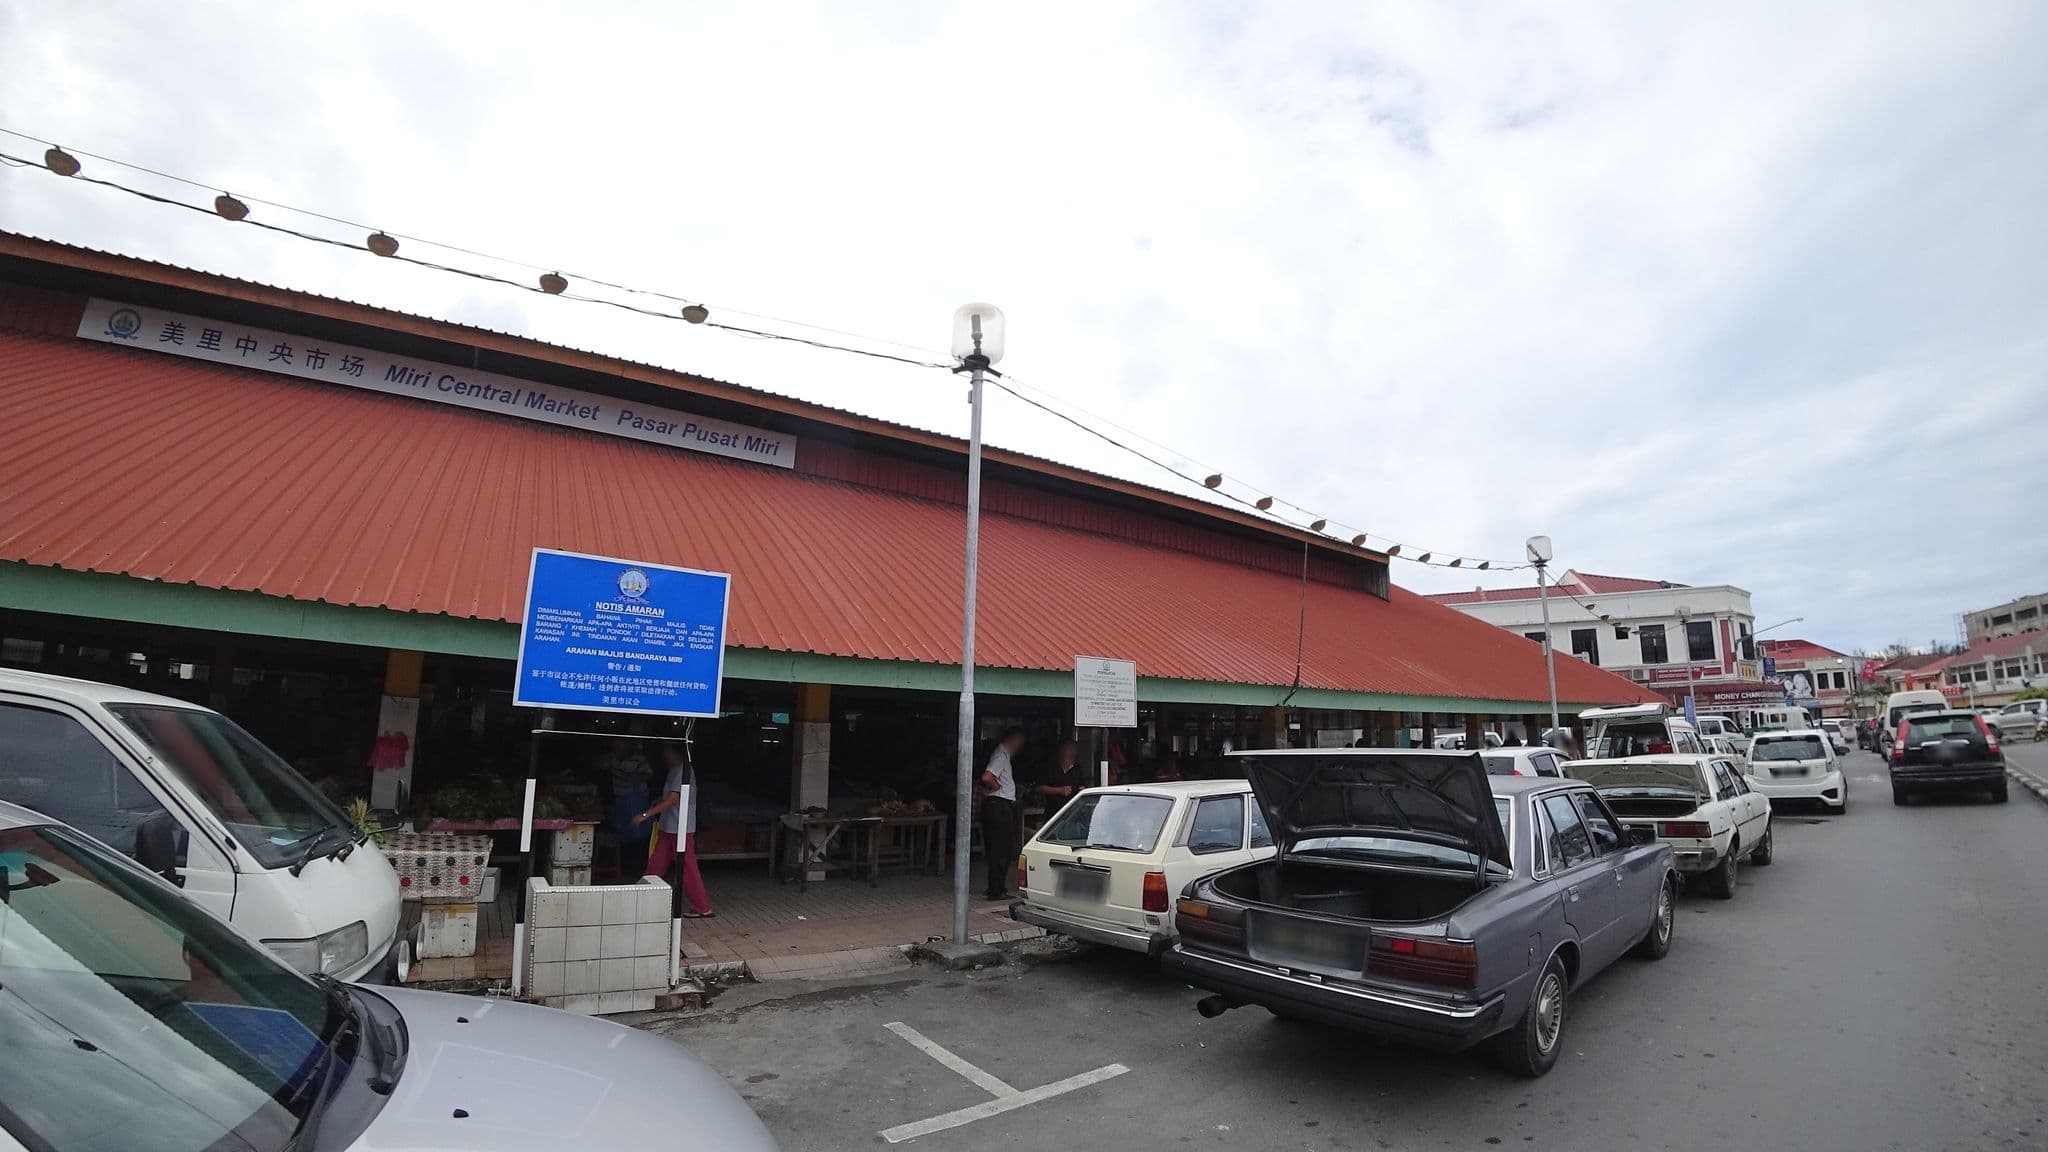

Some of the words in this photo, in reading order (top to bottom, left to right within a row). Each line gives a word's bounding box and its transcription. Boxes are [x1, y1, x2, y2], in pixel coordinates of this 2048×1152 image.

[159, 321, 364, 377] 美里中央市场
[384, 364, 432, 388] Miri
[437, 374, 522, 405] Central
[524, 391, 601, 421] Market
[617, 409, 678, 435] Pasar
[682, 423, 740, 448] Pusat
[743, 435, 780, 456] Miri
[595, 601, 624, 612] NOTIS
[625, 605, 665, 617] AMARAN
[536, 614, 584, 624] MEMBENARKAN
[587, 619, 613, 627] APA-APA
[616, 622, 640, 630] AKTIVITI
[645, 625, 671, 633] BERJAJA
[691, 630, 715, 638] APA-APA
[596, 613, 621, 621] BAHAWA
[635, 617, 653, 625] PIHAK
[699, 624, 715, 632] TIDAK
[534, 628, 565, 636] KAWASAN
[588, 633, 617, 641] TINDAKAN
[644, 638, 667, 646] DIAMBIL
[534, 634, 560, 642] ARAHAN
[535, 620, 562, 629] BARANG
[606, 628, 632, 636] PONDOK
[687, 636, 714, 644] SELURUH
[565, 646, 597, 656] ARAHAN
[598, 649, 624, 658] MAJLIS
[625, 651, 667, 662] BANDARAYA
[1714, 692, 1740, 700] MONEY
